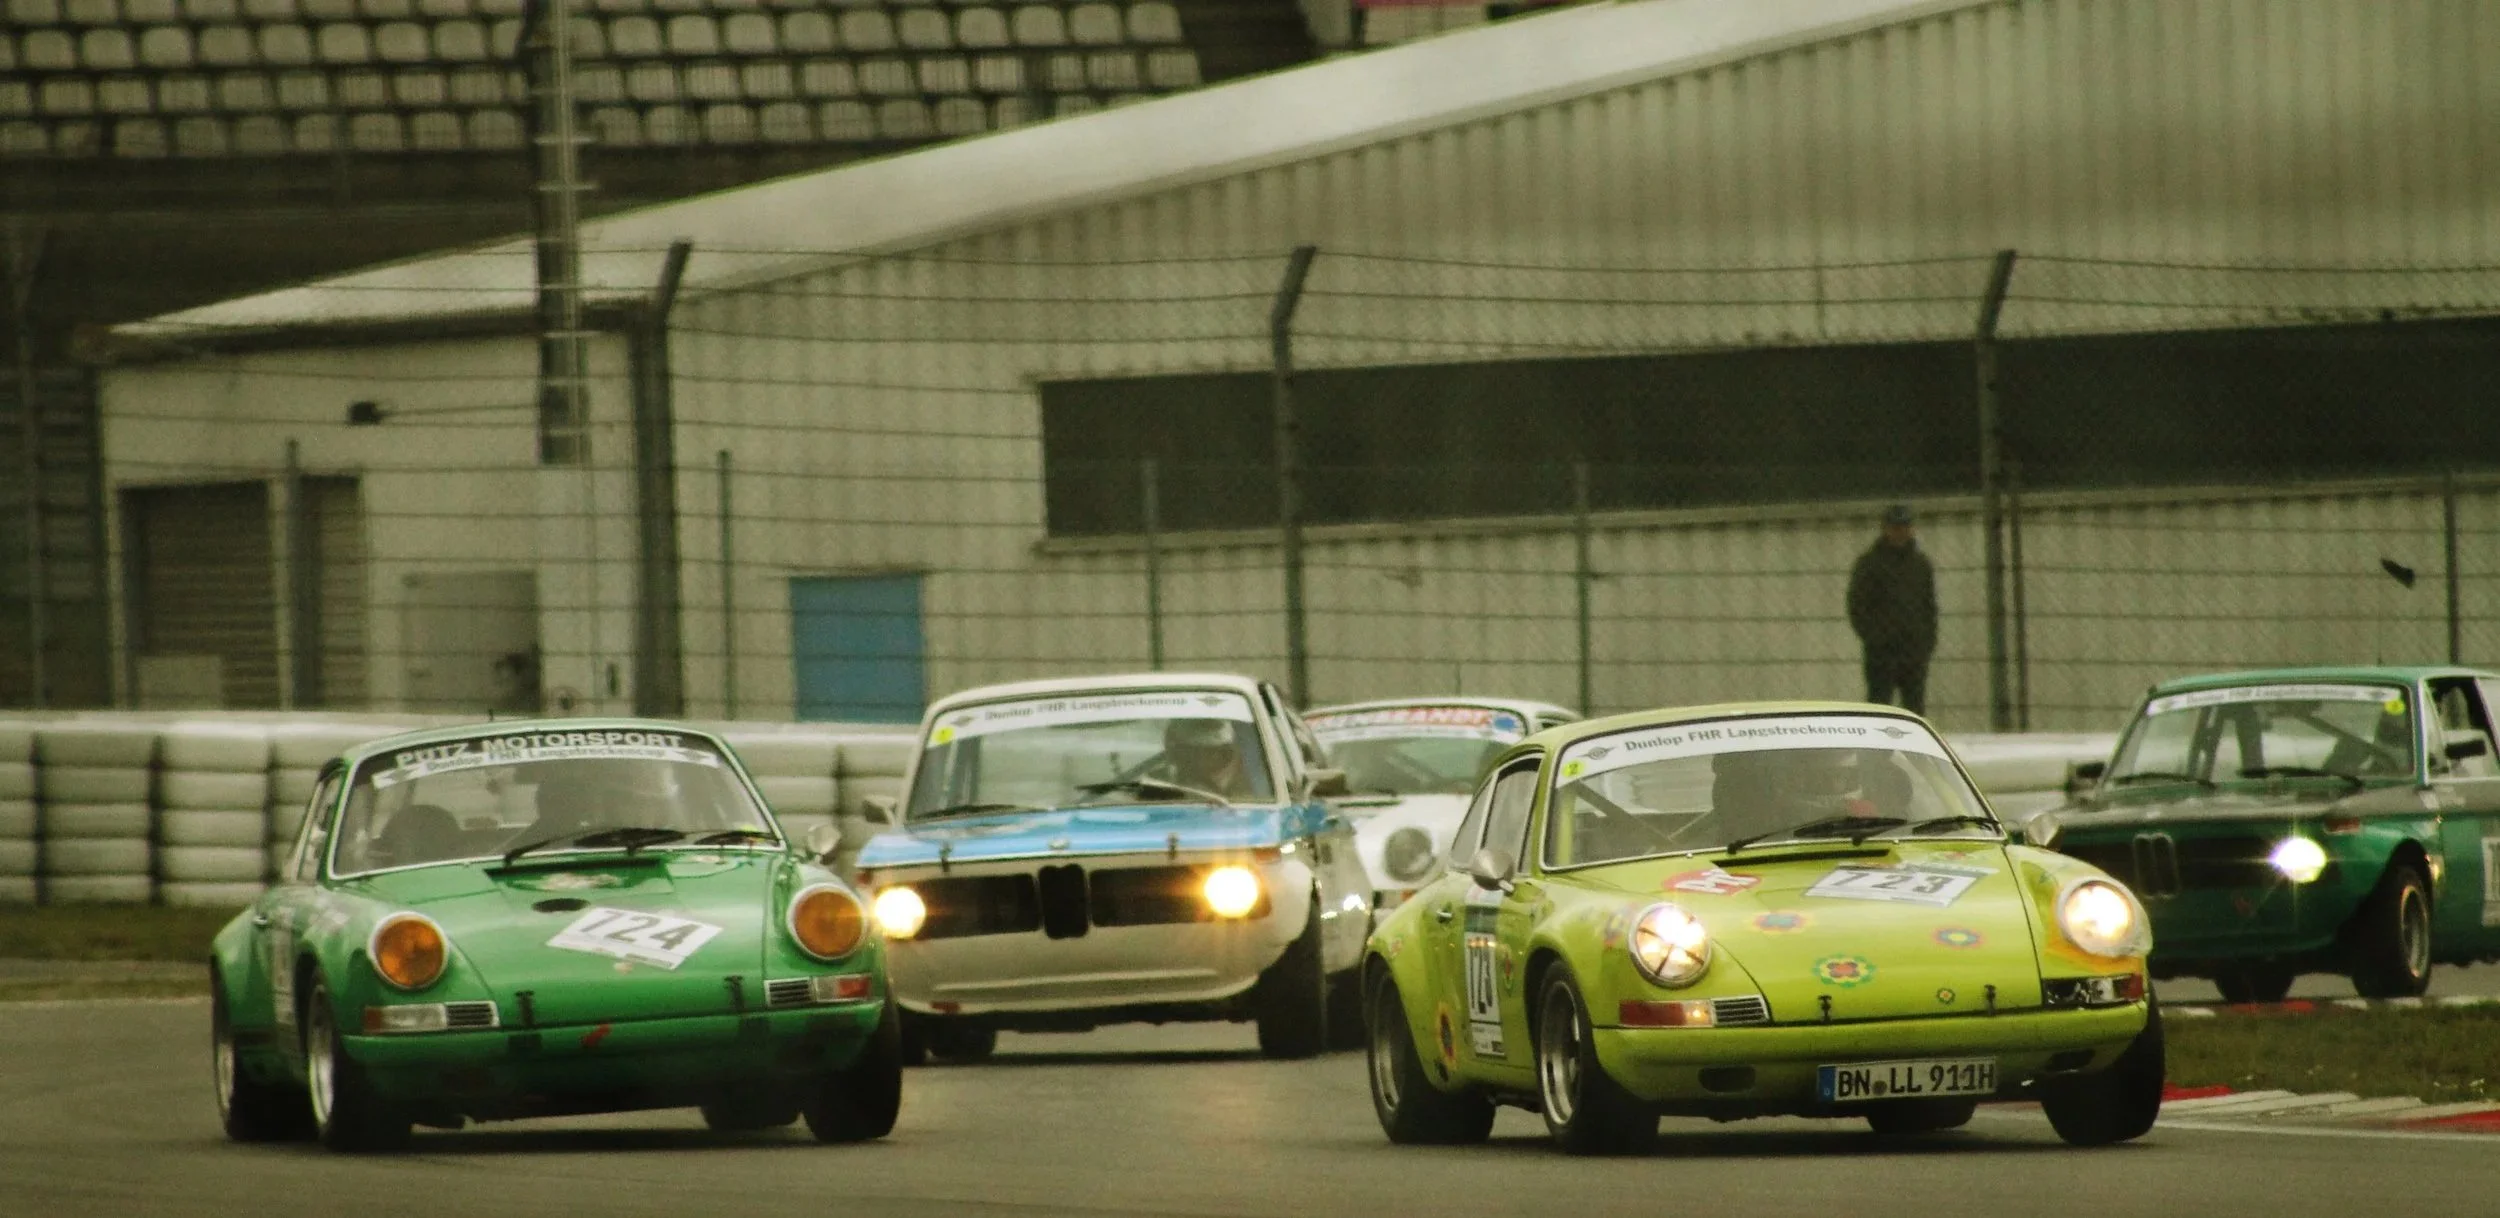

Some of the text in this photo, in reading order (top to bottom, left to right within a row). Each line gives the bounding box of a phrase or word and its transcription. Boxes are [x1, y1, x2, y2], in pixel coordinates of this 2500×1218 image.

[480, 731, 683, 754] MOTORSPORT
[1624, 723, 1868, 752] Dunlop FHR Langstreckencup
[1833, 871, 1956, 895] 723
[579, 910, 703, 951] 724
[1838, 1063, 1995, 1098] BN LL 911H
